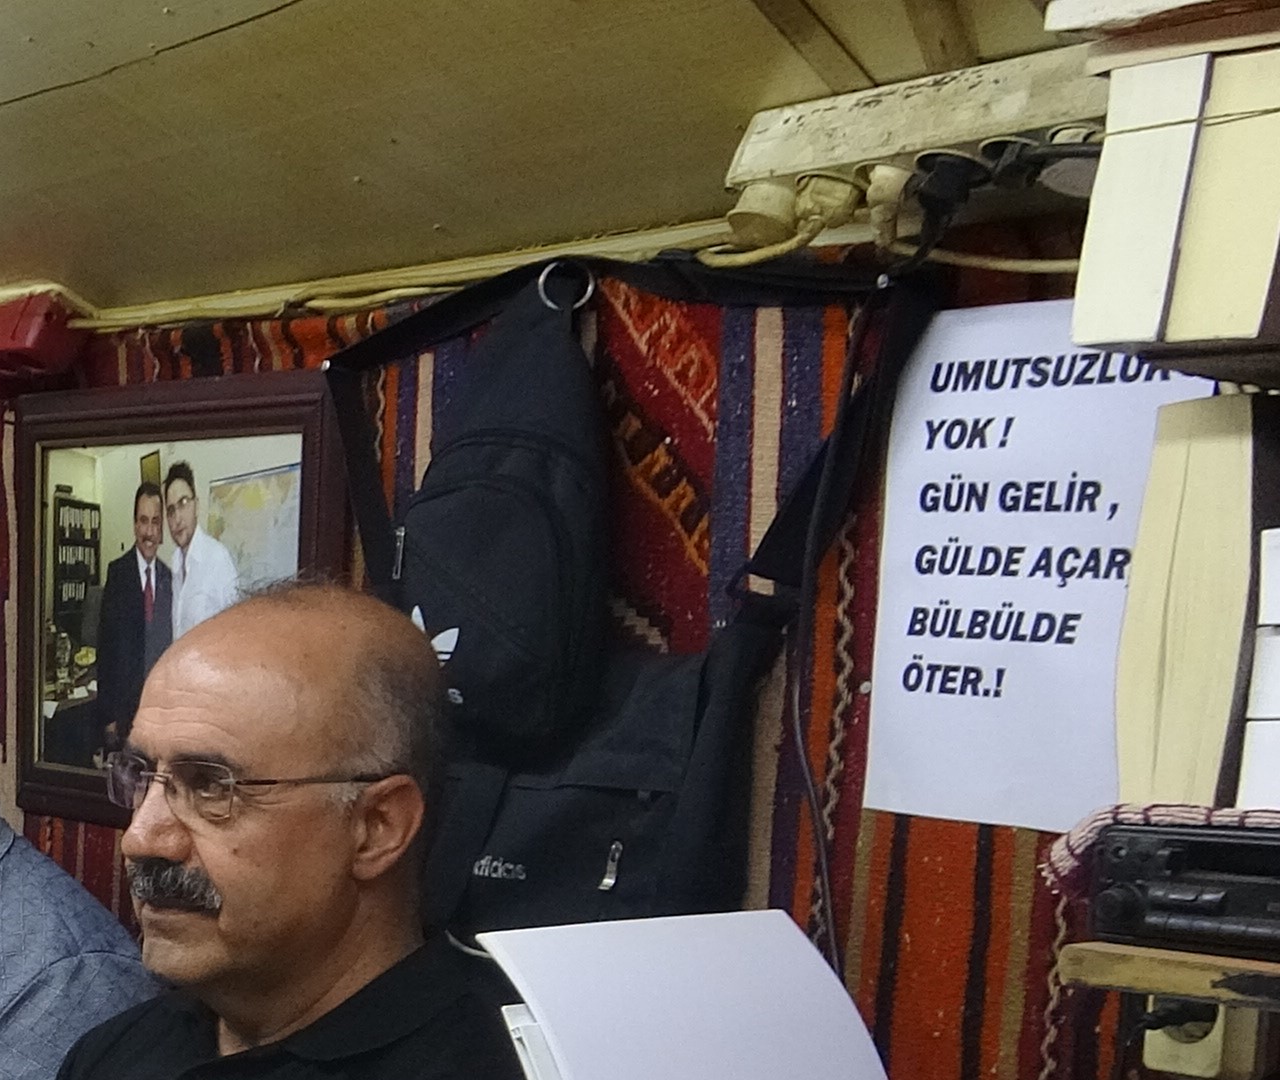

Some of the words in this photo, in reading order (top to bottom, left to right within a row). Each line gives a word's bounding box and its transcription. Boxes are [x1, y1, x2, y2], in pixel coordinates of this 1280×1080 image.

[924, 418, 994, 451] YOK
[998, 417, 1015, 448] !
[919, 474, 989, 513] GÜN
[998, 471, 1102, 513] GELİR
[915, 537, 1025, 577] GÜLDE
[907, 600, 1081, 645] BÜLBÜLDE
[902, 655, 1006, 698] ÖTER.!
